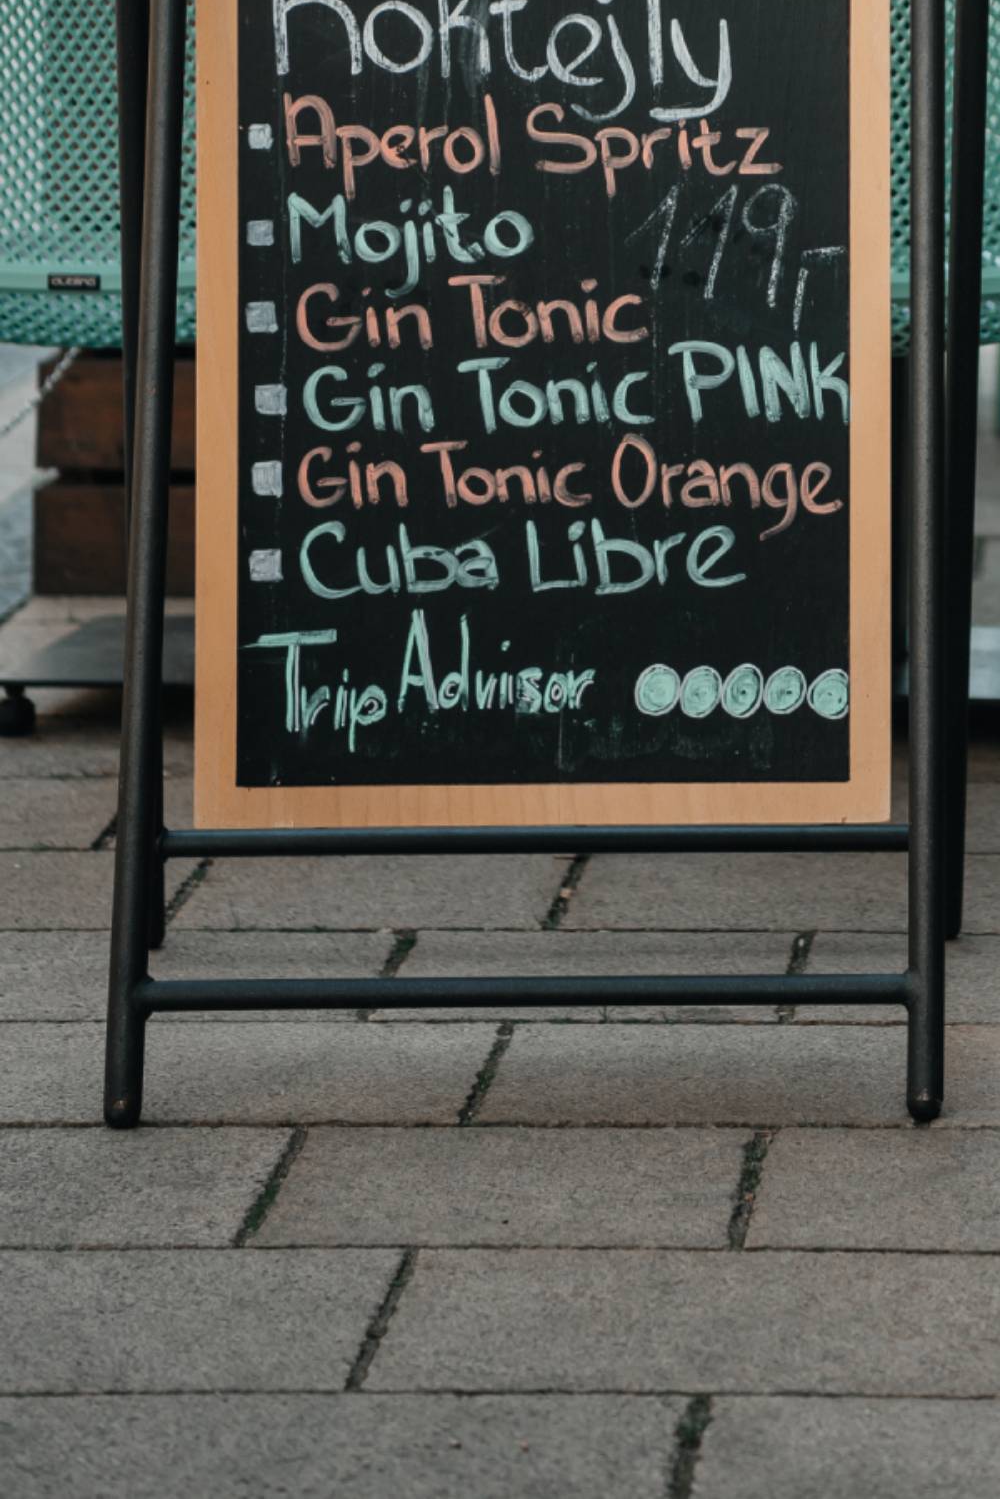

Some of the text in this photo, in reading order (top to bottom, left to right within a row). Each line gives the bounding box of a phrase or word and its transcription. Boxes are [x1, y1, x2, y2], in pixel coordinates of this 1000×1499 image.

[283, 91, 784, 201] Aperol Spritz
[287, 184, 534, 297] Mojito
[296, 274, 650, 352] Gin Tonic
[302, 339, 849, 435] Gin Tonic PINK
[297, 433, 844, 541] Gin Tonic Orange
[299, 517, 747, 599] Cuba Libre
